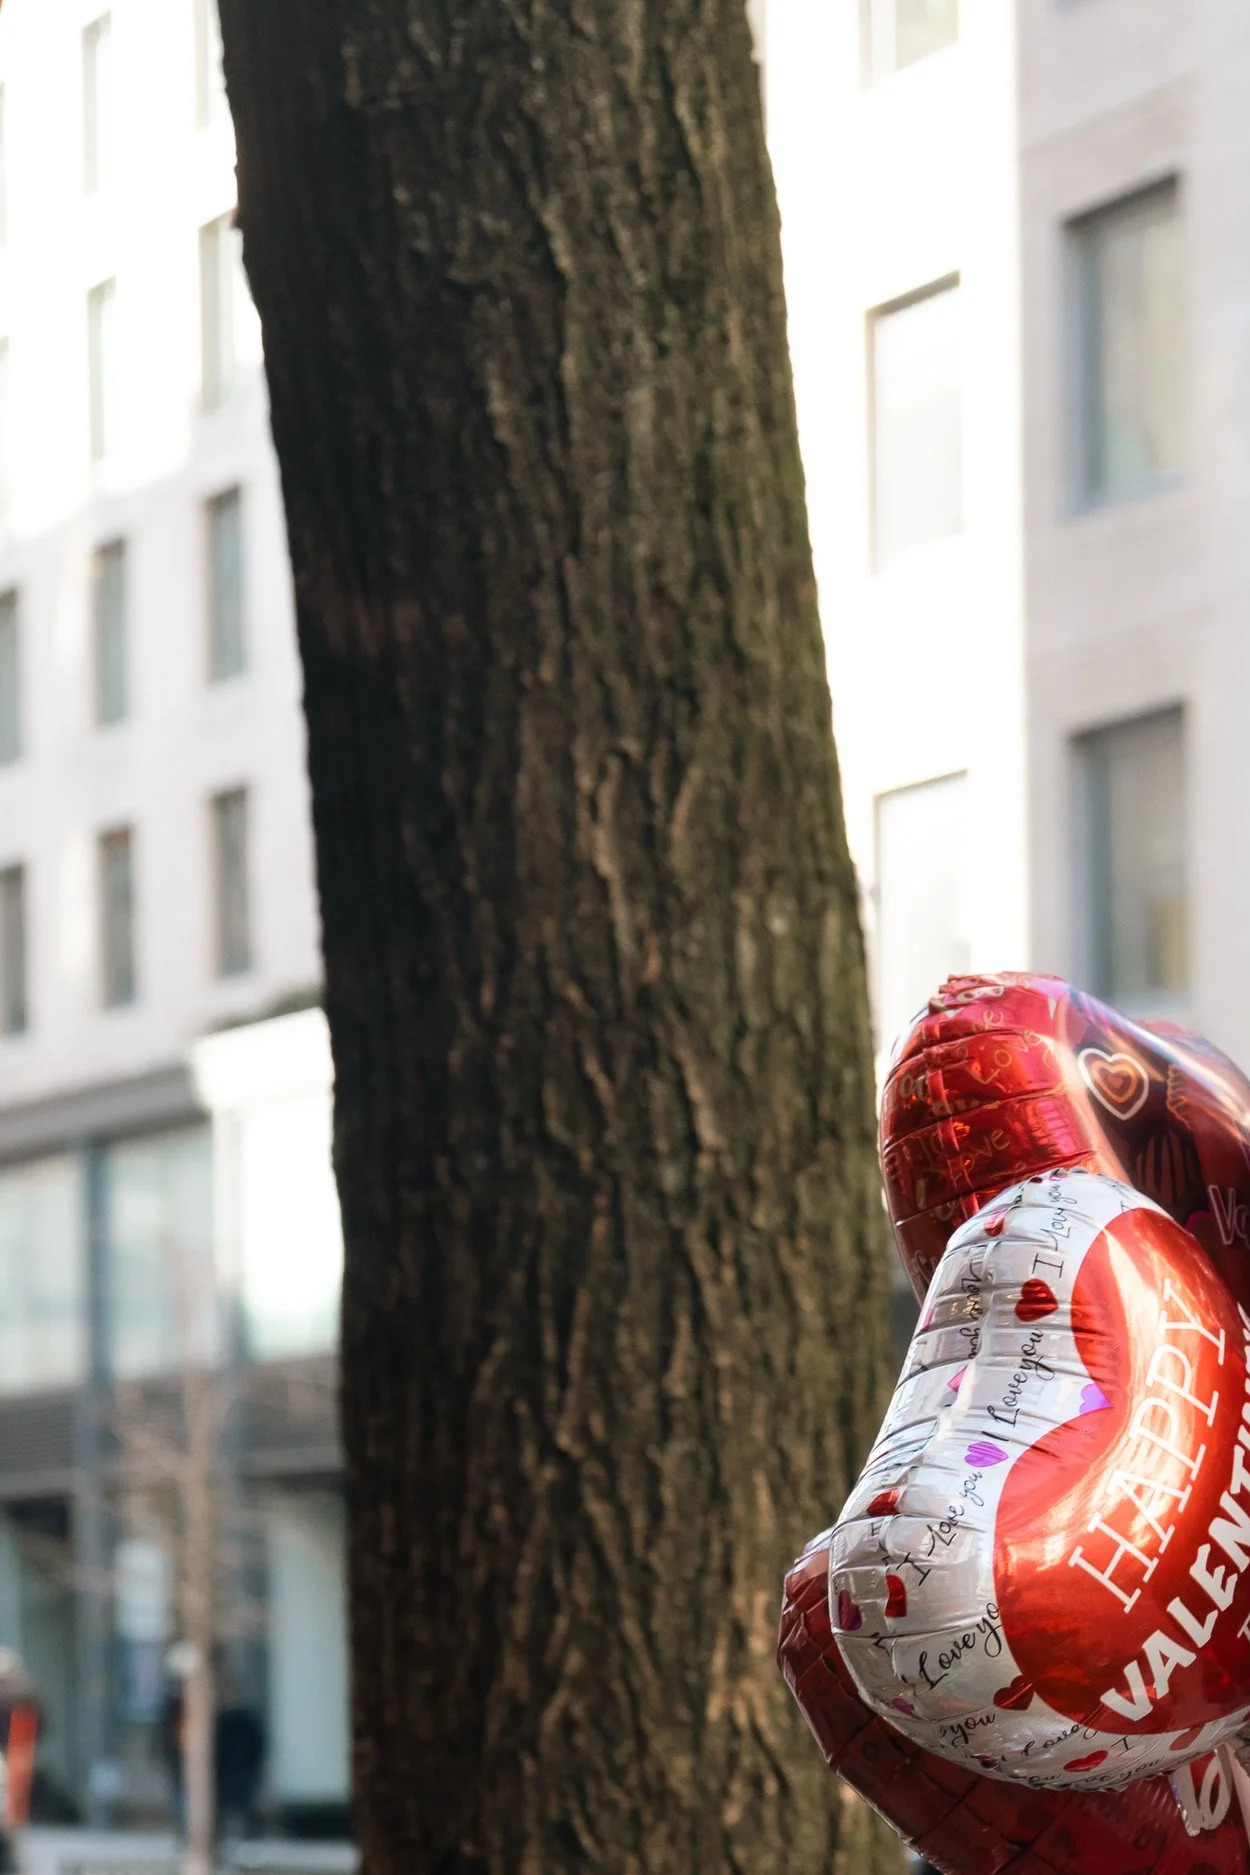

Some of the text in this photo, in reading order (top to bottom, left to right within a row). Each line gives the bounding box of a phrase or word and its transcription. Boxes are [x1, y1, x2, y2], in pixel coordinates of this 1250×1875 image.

[986, 1370, 1029, 1428] Love
[1019, 1327, 1056, 1382] you
[1068, 1277, 1226, 1614] HAPPY
[896, 1470, 985, 1587] I Love you
[919, 1631, 977, 1691] Love
[950, 1712, 996, 1747] you
